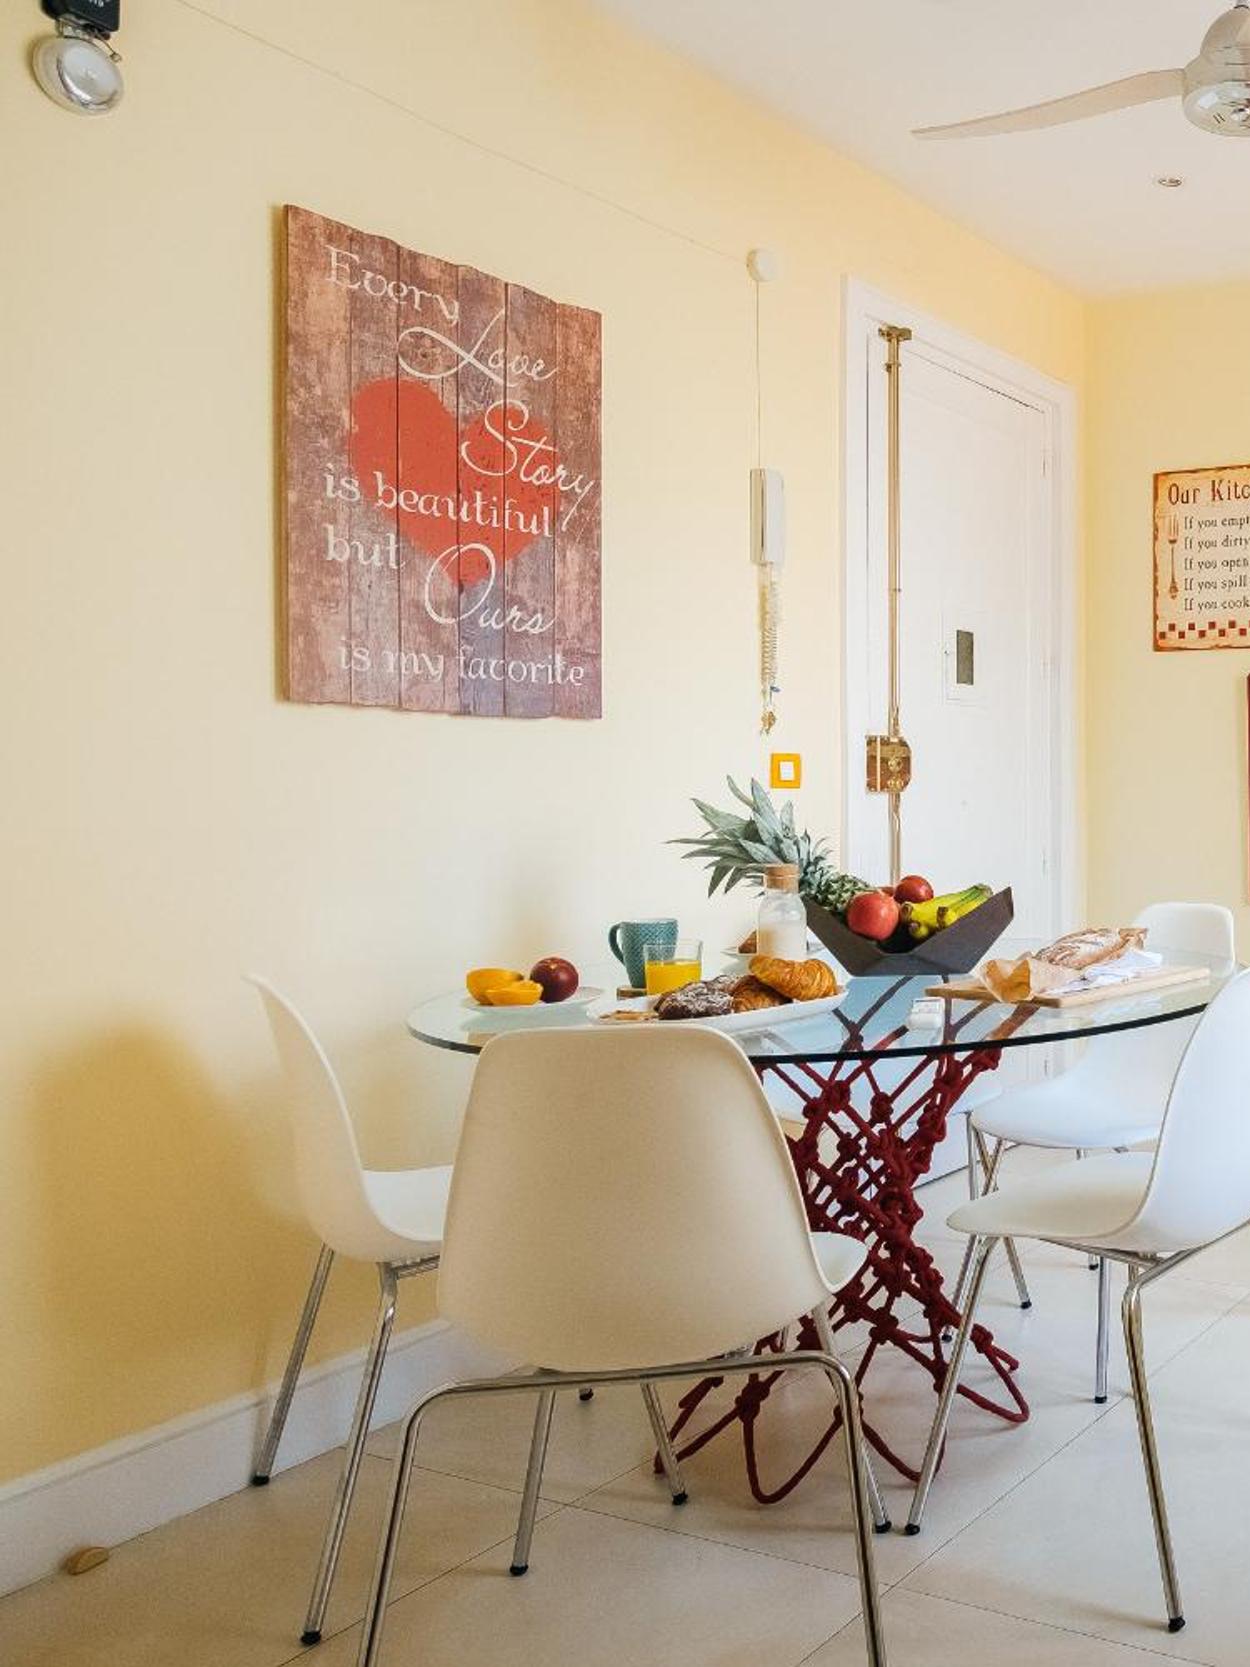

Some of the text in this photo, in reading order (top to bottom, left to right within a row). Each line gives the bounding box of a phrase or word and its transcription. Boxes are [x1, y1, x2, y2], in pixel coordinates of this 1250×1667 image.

[325, 245, 460, 324] Every
[398, 310, 557, 387] Love
[461, 400, 595, 530] Story
[325, 464, 553, 537] is beautiful
[1168, 483, 1200, 505] Our
[1184, 516, 1194, 529] If
[1198, 519, 1217, 531] you
[1184, 537, 1194, 550] If
[1198, 540, 1217, 552] you
[1221, 534, 1250, 547] dirty
[325, 525, 557, 635] but Ours
[1184, 558, 1194, 571] If
[1198, 560, 1217, 572] you
[1221, 558, 1249, 571] open
[1184, 578, 1194, 592] If
[1198, 581, 1217, 594] you
[1221, 576, 1248, 590] spill
[1184, 598, 1194, 611] If
[1198, 601, 1217, 613] you
[1221, 597, 1250, 609] cook
[340, 640, 585, 687] is my favorite
